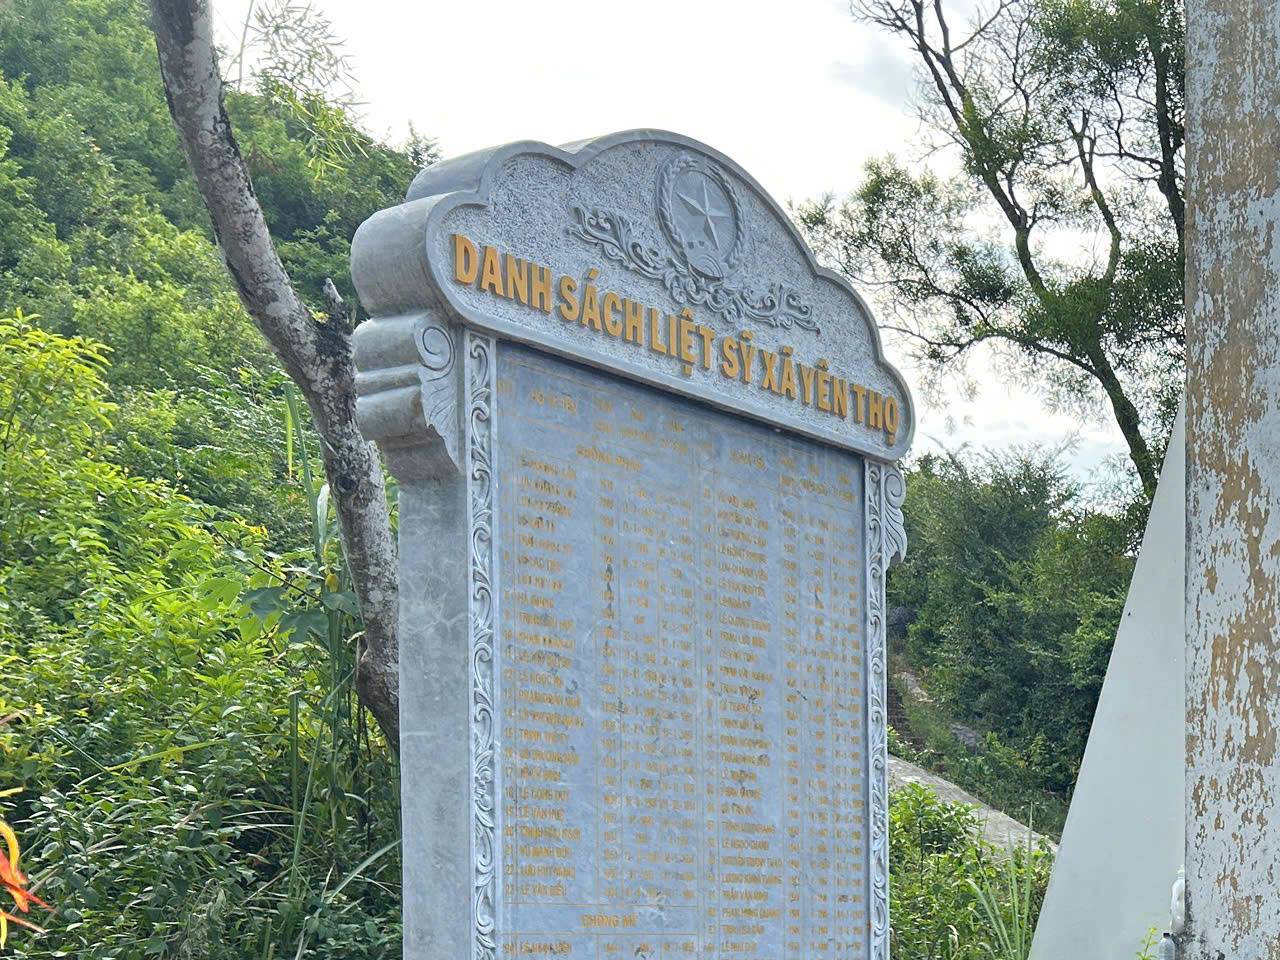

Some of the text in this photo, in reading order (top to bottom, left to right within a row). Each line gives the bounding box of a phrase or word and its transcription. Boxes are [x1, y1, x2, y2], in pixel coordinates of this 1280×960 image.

[452, 233, 899, 447] DANH SÁCH LIỆT SỸ XÃ YÊN THỌ
